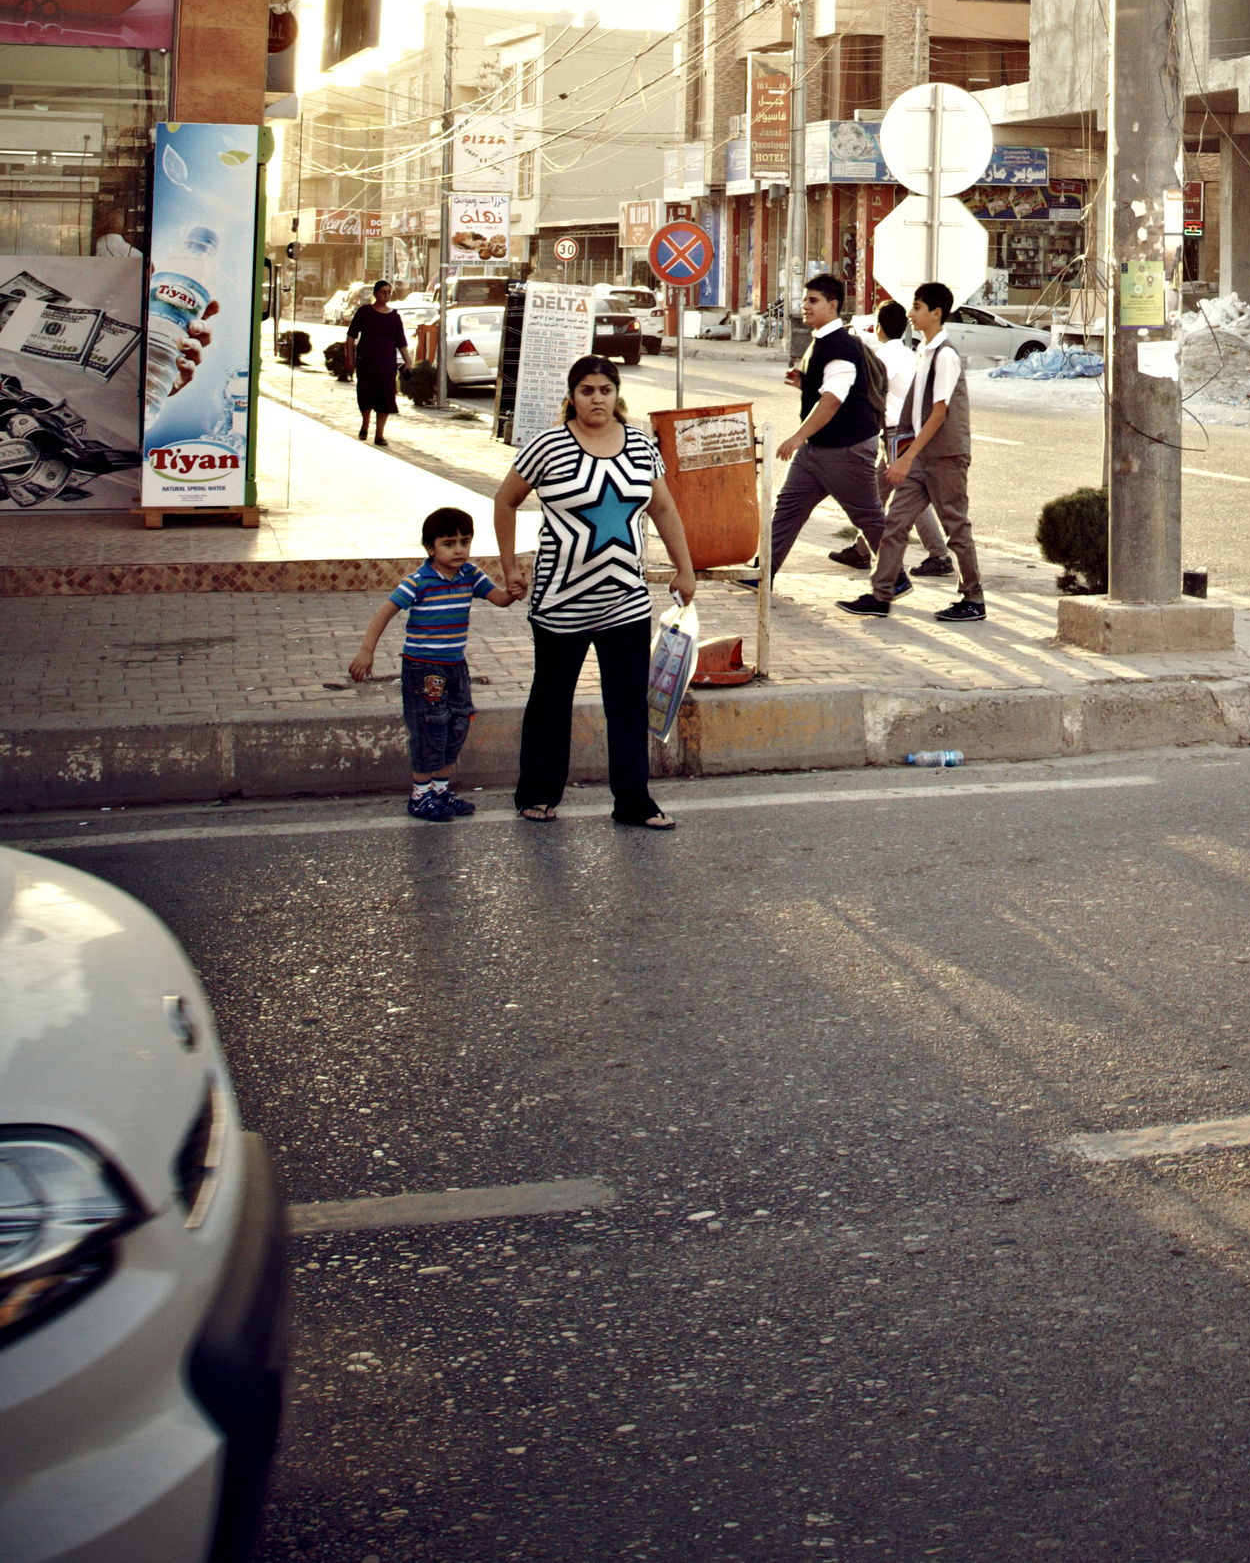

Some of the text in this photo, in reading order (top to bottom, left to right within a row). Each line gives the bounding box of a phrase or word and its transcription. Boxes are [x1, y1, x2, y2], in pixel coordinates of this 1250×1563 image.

[758, 96, 784, 107] جبل
[759, 128, 782, 136] Jabal
[462, 135, 506, 144] PIZZA
[751, 140, 789, 153] Qassioun
[755, 153, 785, 162] HOTEL
[460, 209, 503, 224] نهلة
[559, 244, 574, 255] 30
[158, 285, 196, 308] Tiyan
[532, 295, 588, 313] DELTA
[52, 344, 78, 353] 100
[149, 448, 240, 474] Tiyan
